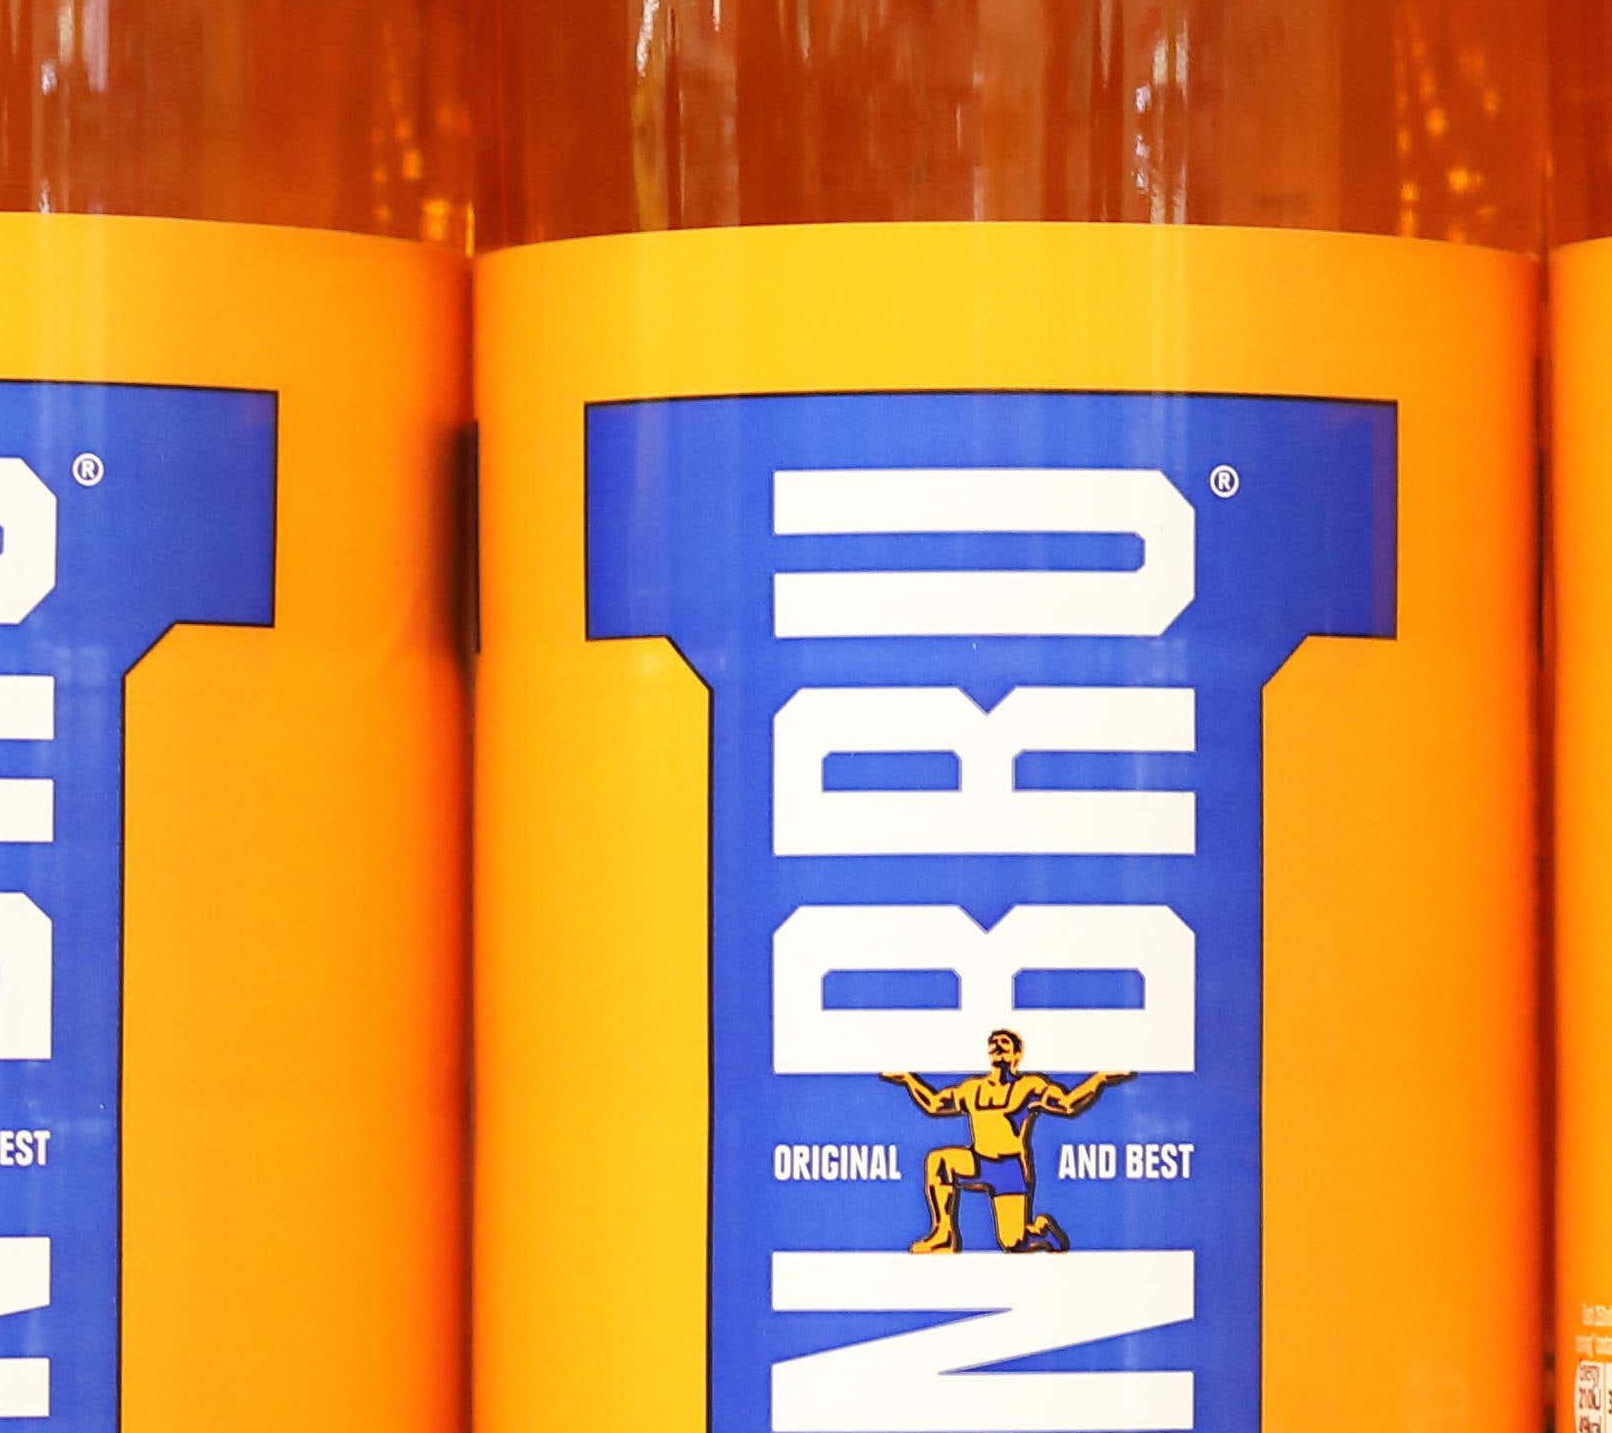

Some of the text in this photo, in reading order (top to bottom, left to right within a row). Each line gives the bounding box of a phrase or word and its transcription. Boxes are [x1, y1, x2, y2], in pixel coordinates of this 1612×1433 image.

[773, 468, 1195, 1075] BRU
[775, 1144, 1194, 1180] ORIGINAL AND BEST
